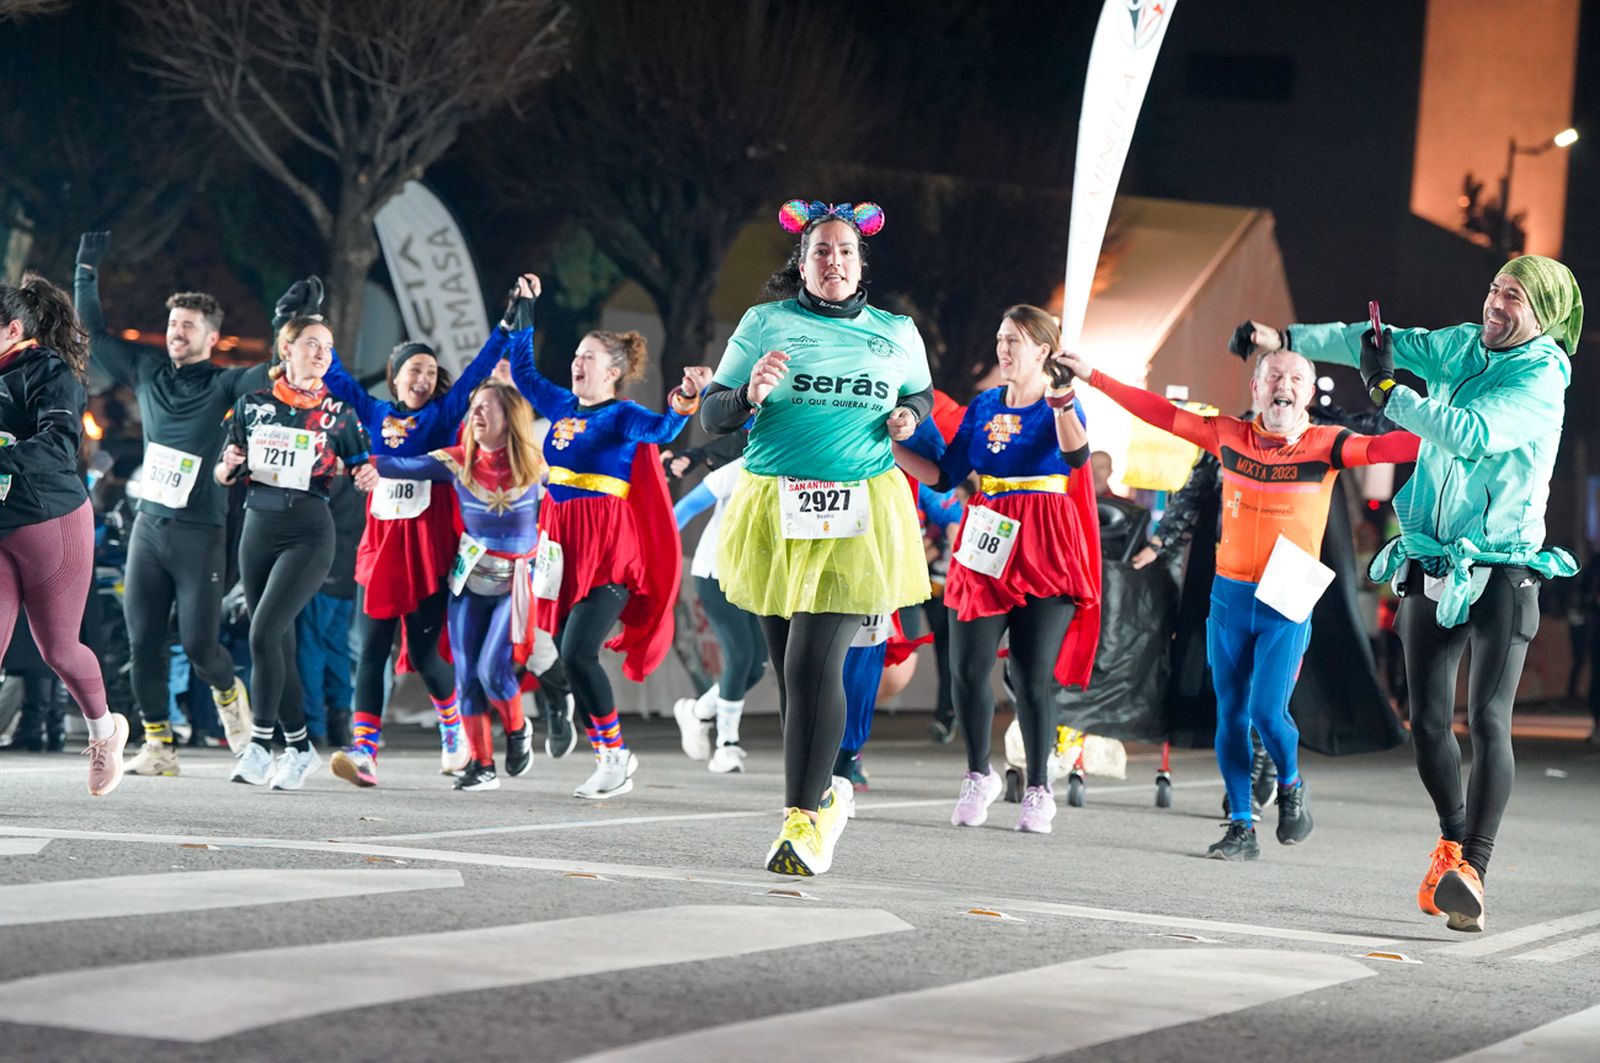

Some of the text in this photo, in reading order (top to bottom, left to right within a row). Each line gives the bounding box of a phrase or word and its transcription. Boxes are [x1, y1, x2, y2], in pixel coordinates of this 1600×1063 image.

[792, 373, 890, 399] serás
[808, 398, 827, 406] QUE
[832, 399, 869, 409] QUIERAS
[871, 403, 884, 412] SER
[263, 447, 296, 467] 7211
[1236, 457, 1298, 480] MIXTA 2023
[150, 465, 182, 488] 3579
[789, 482, 805, 491] SAN
[798, 489, 850, 512] 2927
